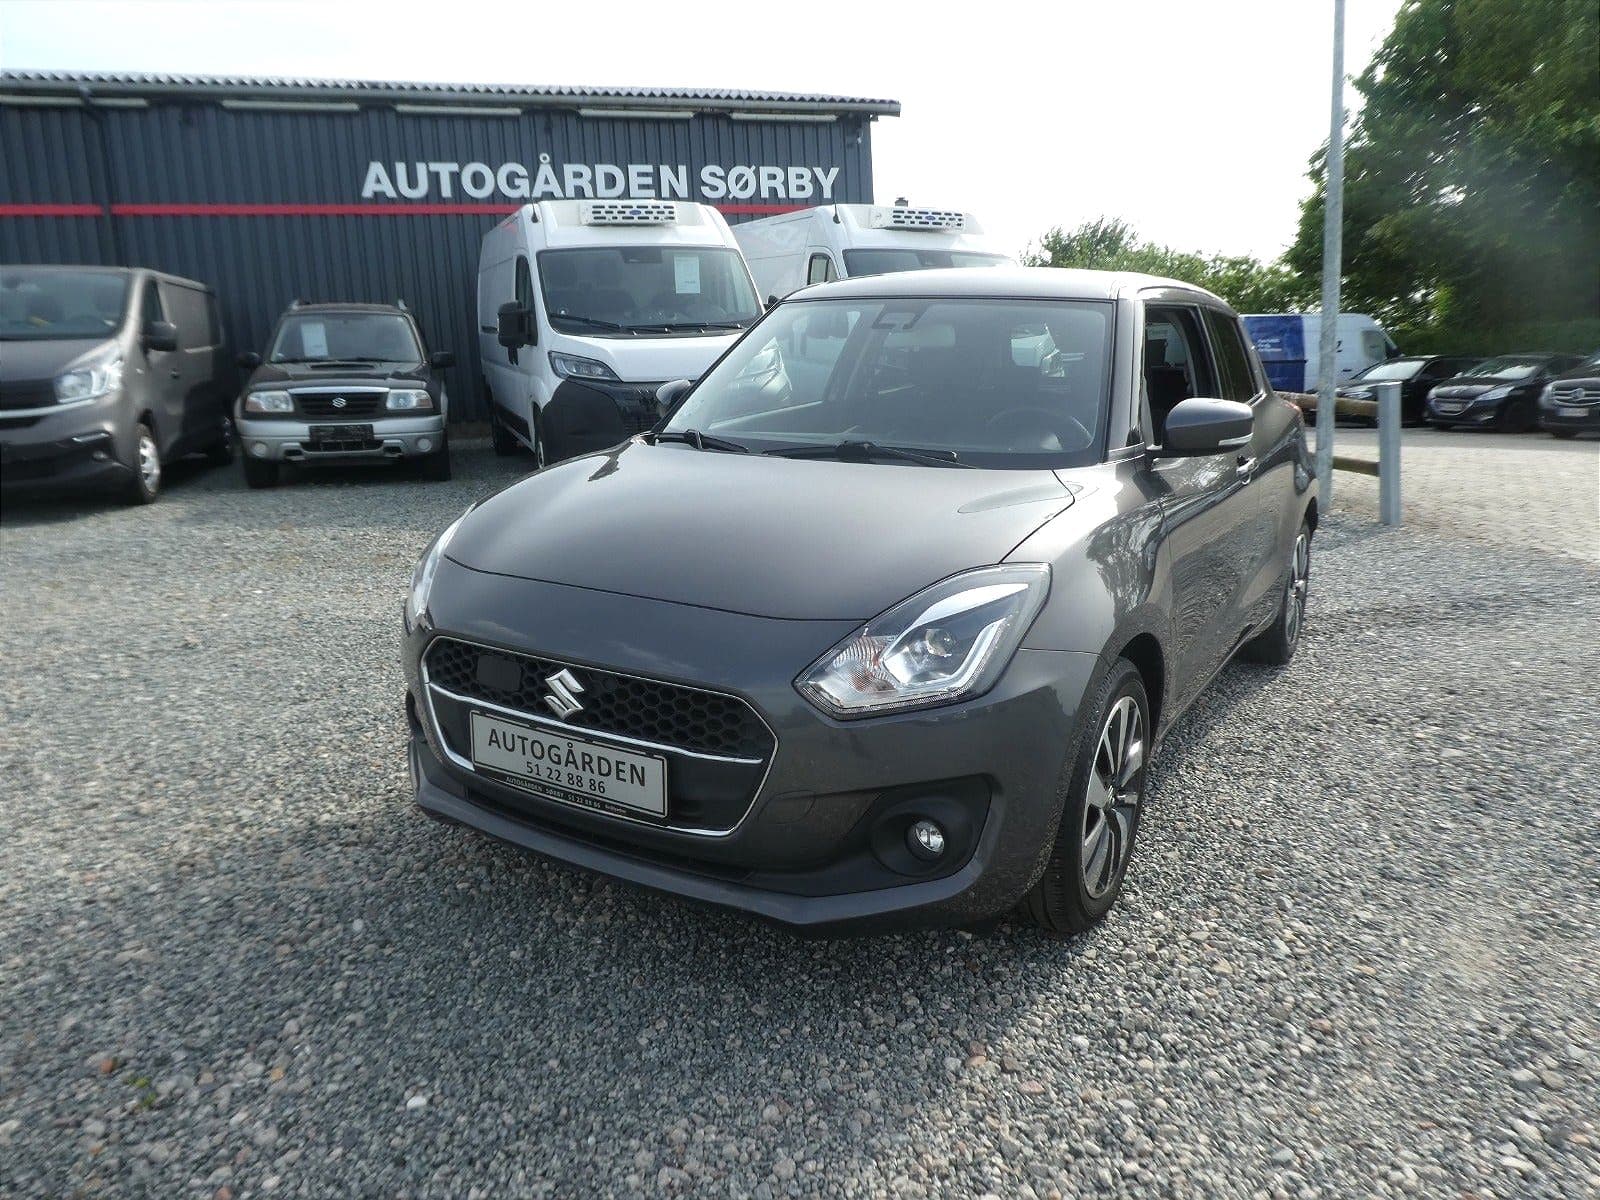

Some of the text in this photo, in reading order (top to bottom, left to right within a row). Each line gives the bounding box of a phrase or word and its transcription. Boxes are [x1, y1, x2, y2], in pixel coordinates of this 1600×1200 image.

[361, 153, 840, 201] AUTOGÅRDEN SØRBY
[488, 728, 646, 787] AUTOGÅRDEN
[526, 761, 606, 794] 51 22 88 86
